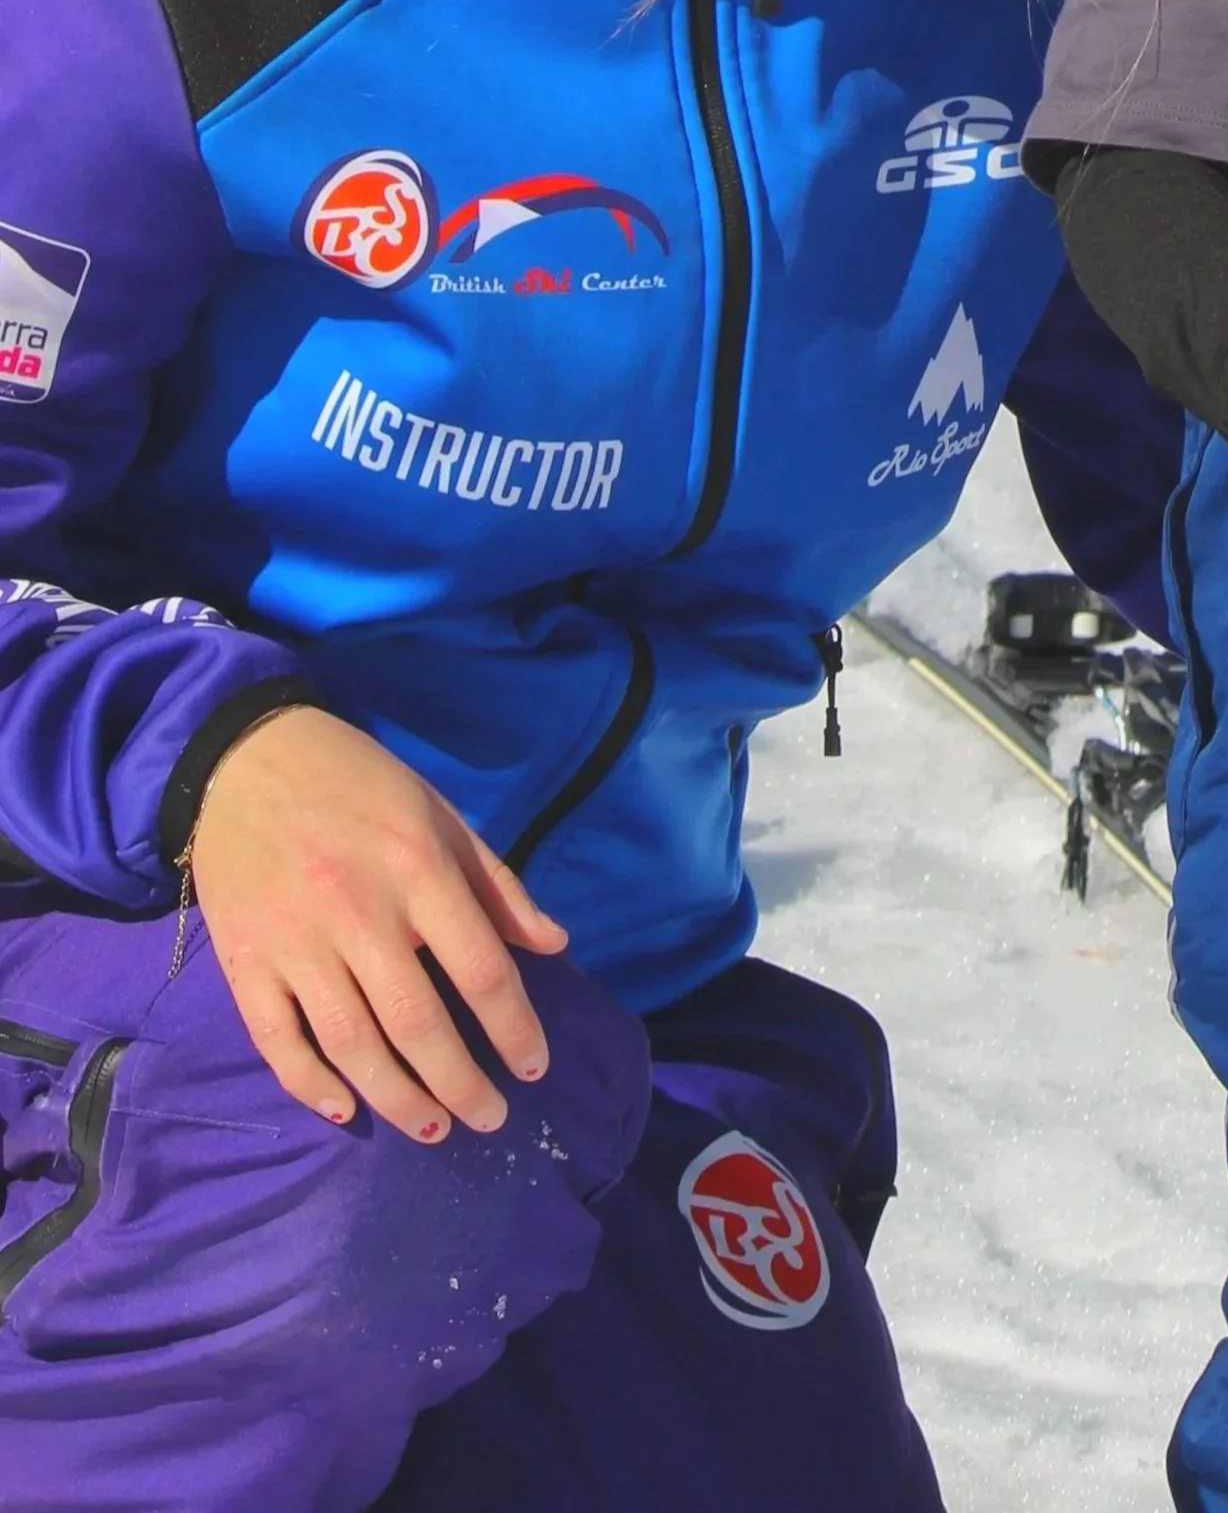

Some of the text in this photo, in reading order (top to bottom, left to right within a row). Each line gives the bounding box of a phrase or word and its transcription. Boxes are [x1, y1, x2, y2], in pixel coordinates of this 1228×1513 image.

[427, 273, 507, 294] British
[581, 271, 668, 292] Center
[310, 369, 624, 512] INSTRUCTOR
[867, 444, 928, 488] Rio
